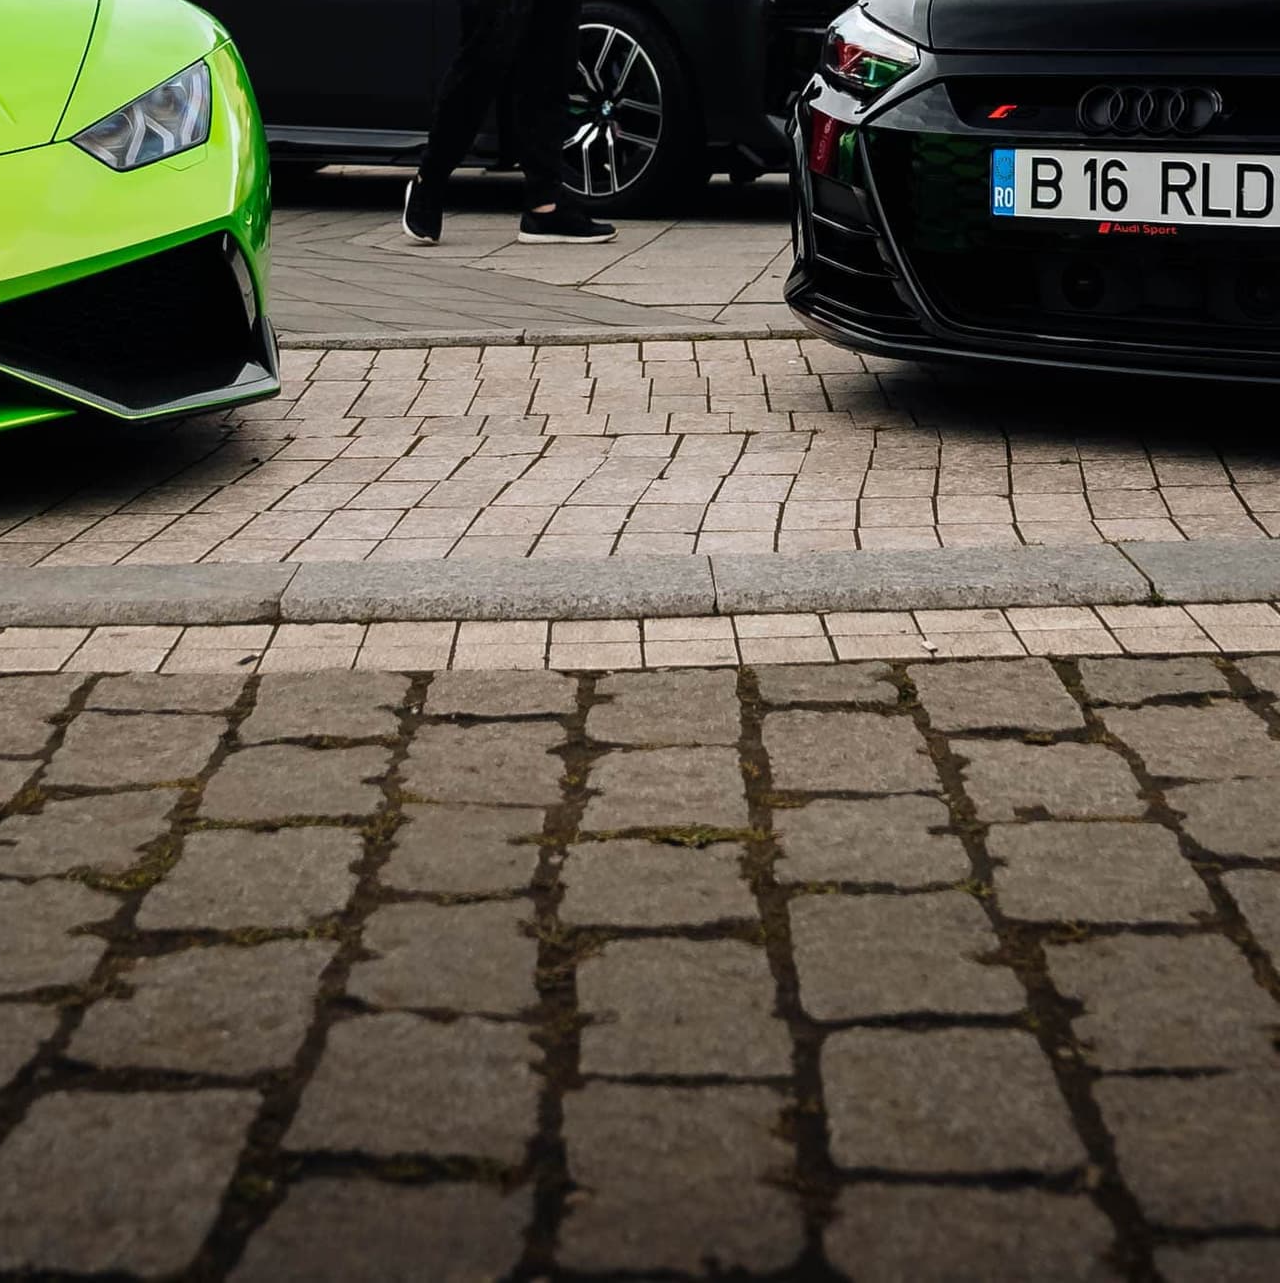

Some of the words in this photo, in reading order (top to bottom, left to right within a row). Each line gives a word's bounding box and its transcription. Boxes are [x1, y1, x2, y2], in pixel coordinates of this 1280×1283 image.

[994, 186, 1015, 208] RO
[1030, 157, 1063, 210] B
[1083, 158, 1129, 212] 16
[1160, 161, 1275, 219] RLD
[1113, 223, 1140, 233] Audi
[1143, 224, 1177, 236] Sport
